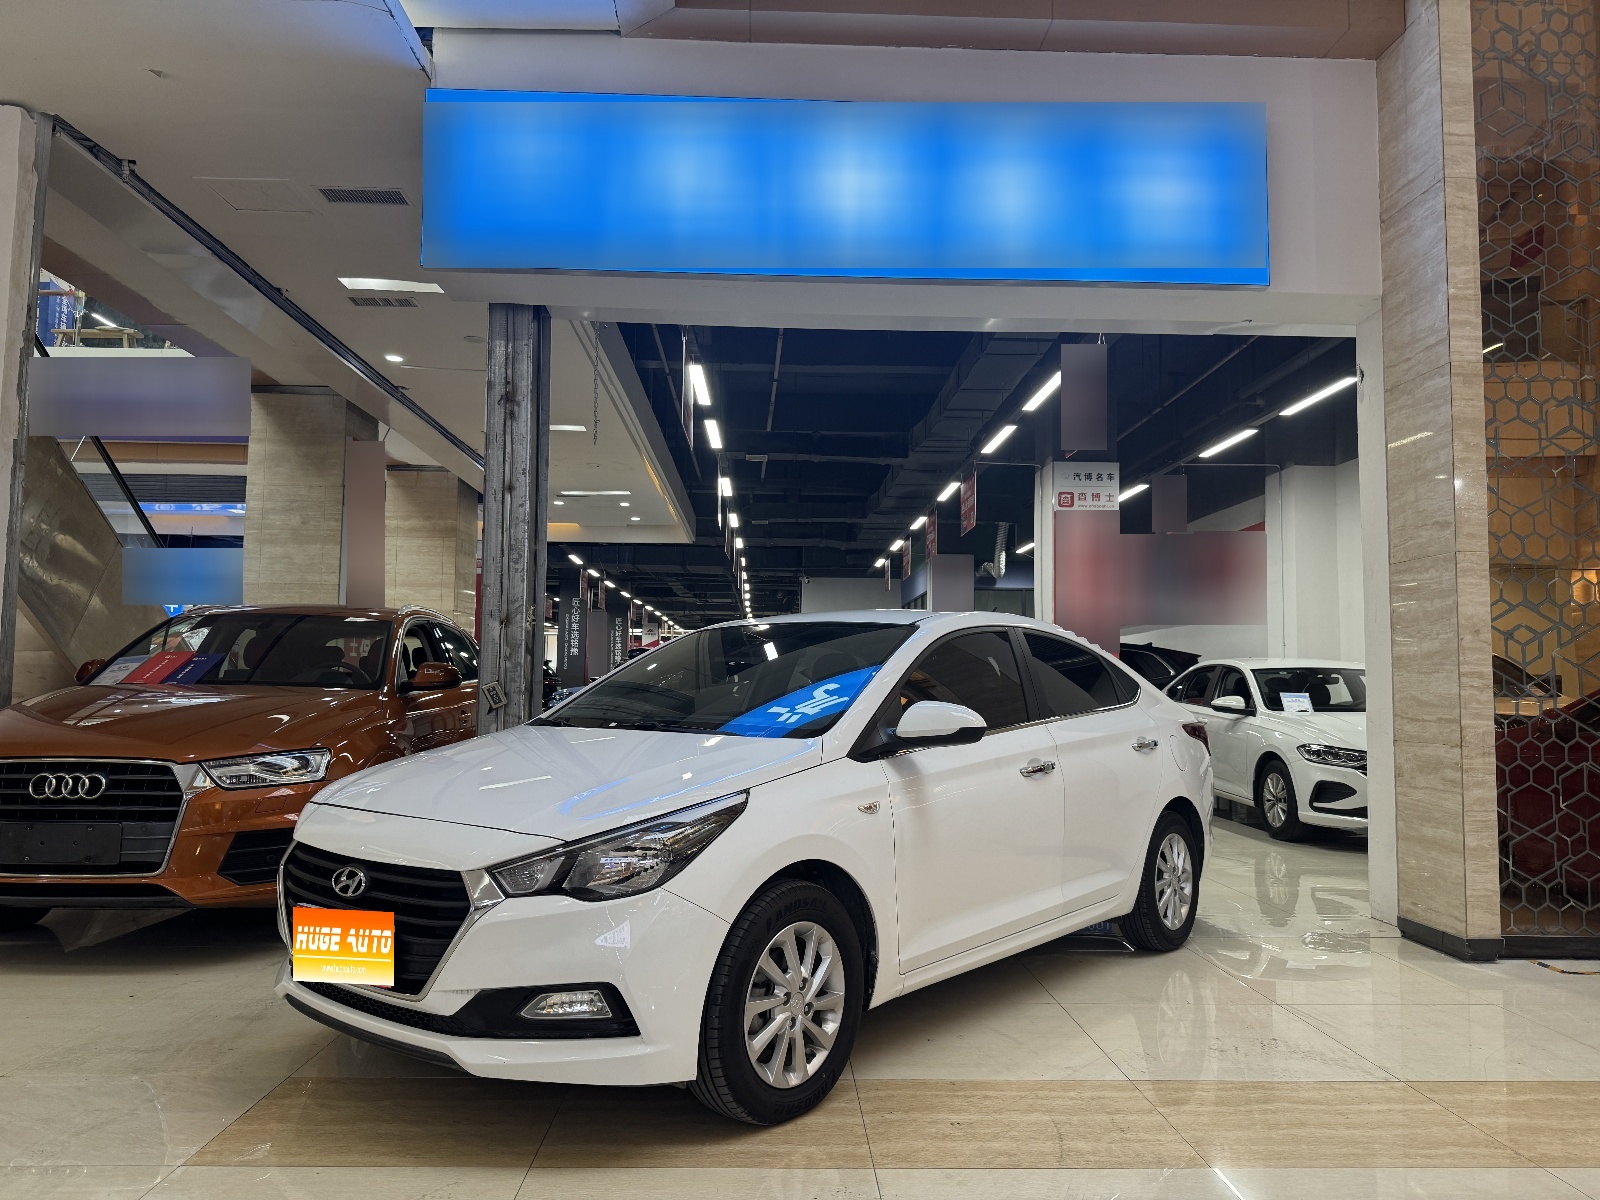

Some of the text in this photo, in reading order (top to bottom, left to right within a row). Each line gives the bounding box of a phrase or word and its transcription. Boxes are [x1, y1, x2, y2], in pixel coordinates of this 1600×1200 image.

[1073, 472, 1115, 482] 汽博名车
[1077, 492, 1115, 503] 查博士
